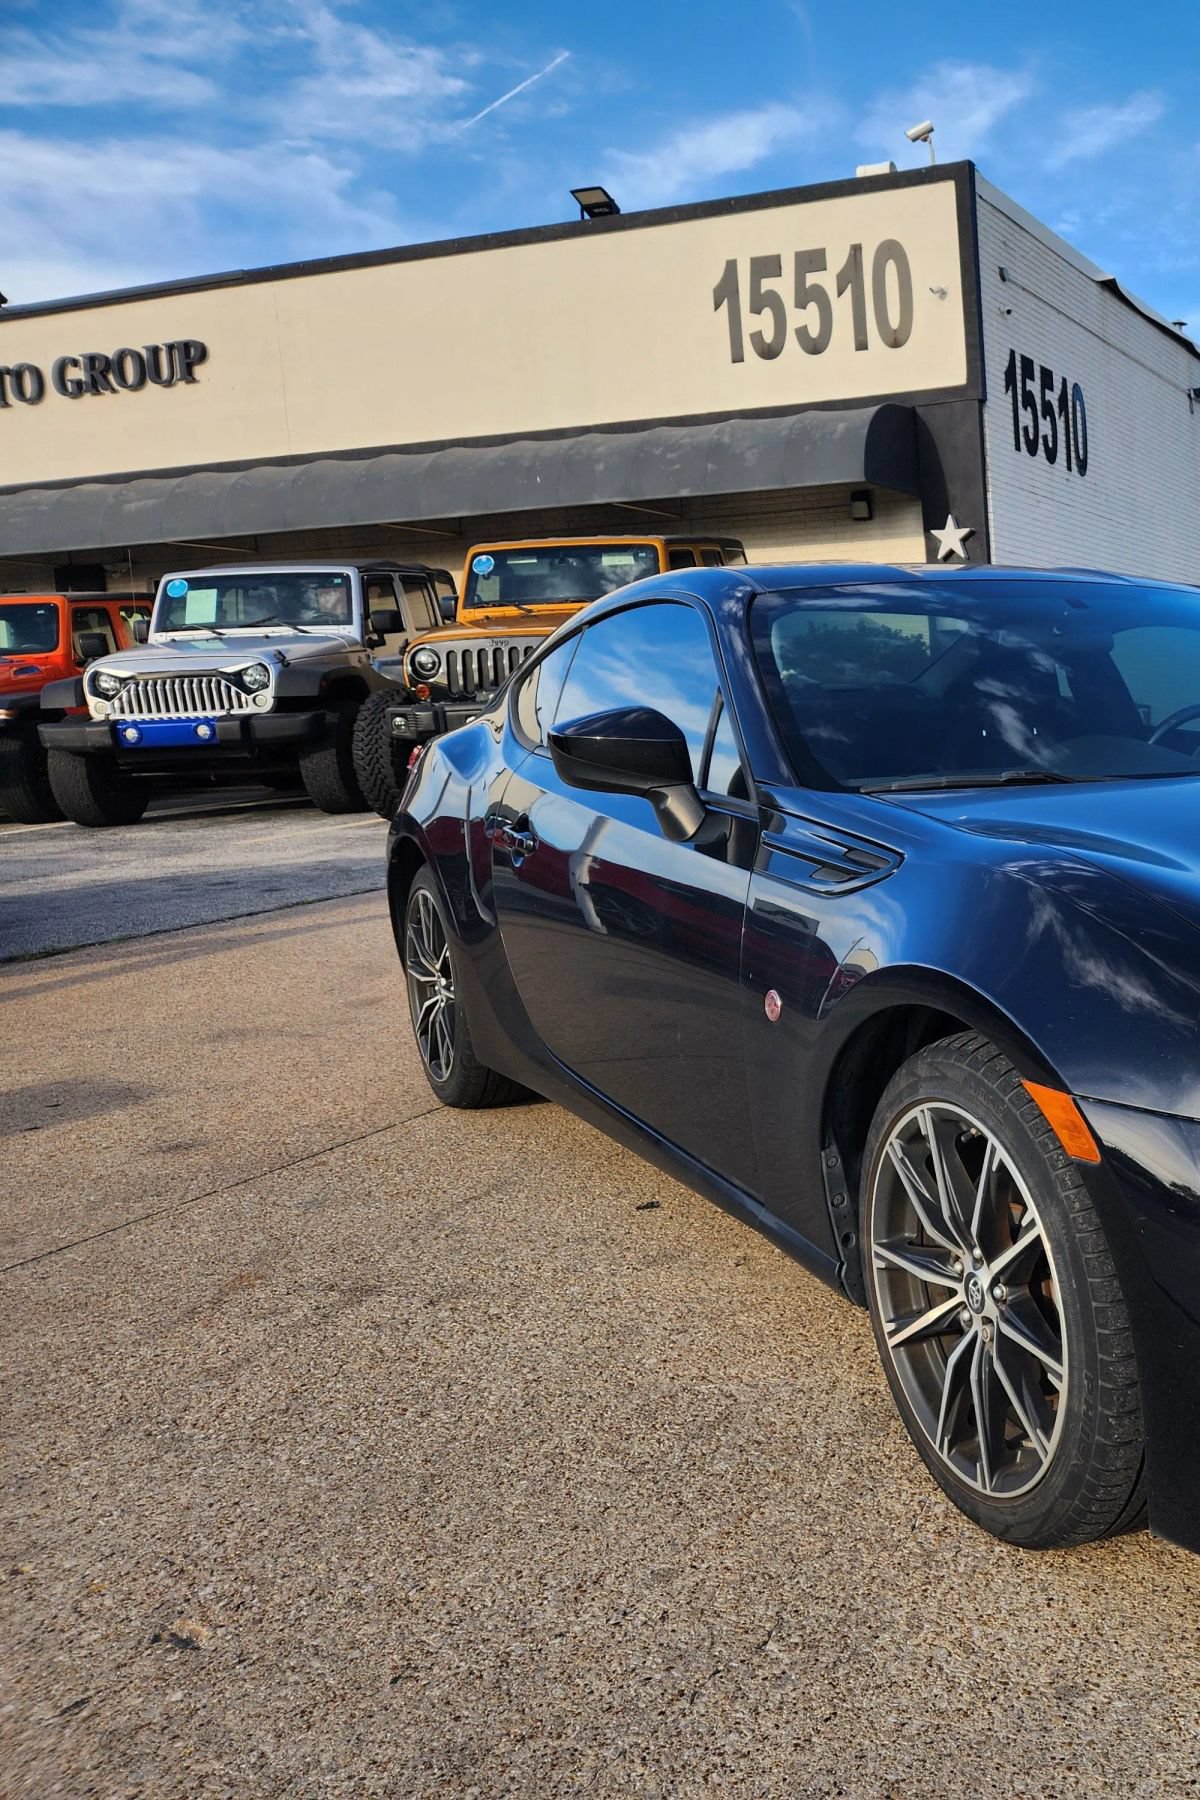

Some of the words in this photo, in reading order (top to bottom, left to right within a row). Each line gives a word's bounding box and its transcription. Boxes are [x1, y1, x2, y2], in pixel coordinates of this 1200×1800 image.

[713, 239, 913, 364] 15510
[52, 339, 209, 399] GROUP
[1004, 348, 1088, 477] 15510
